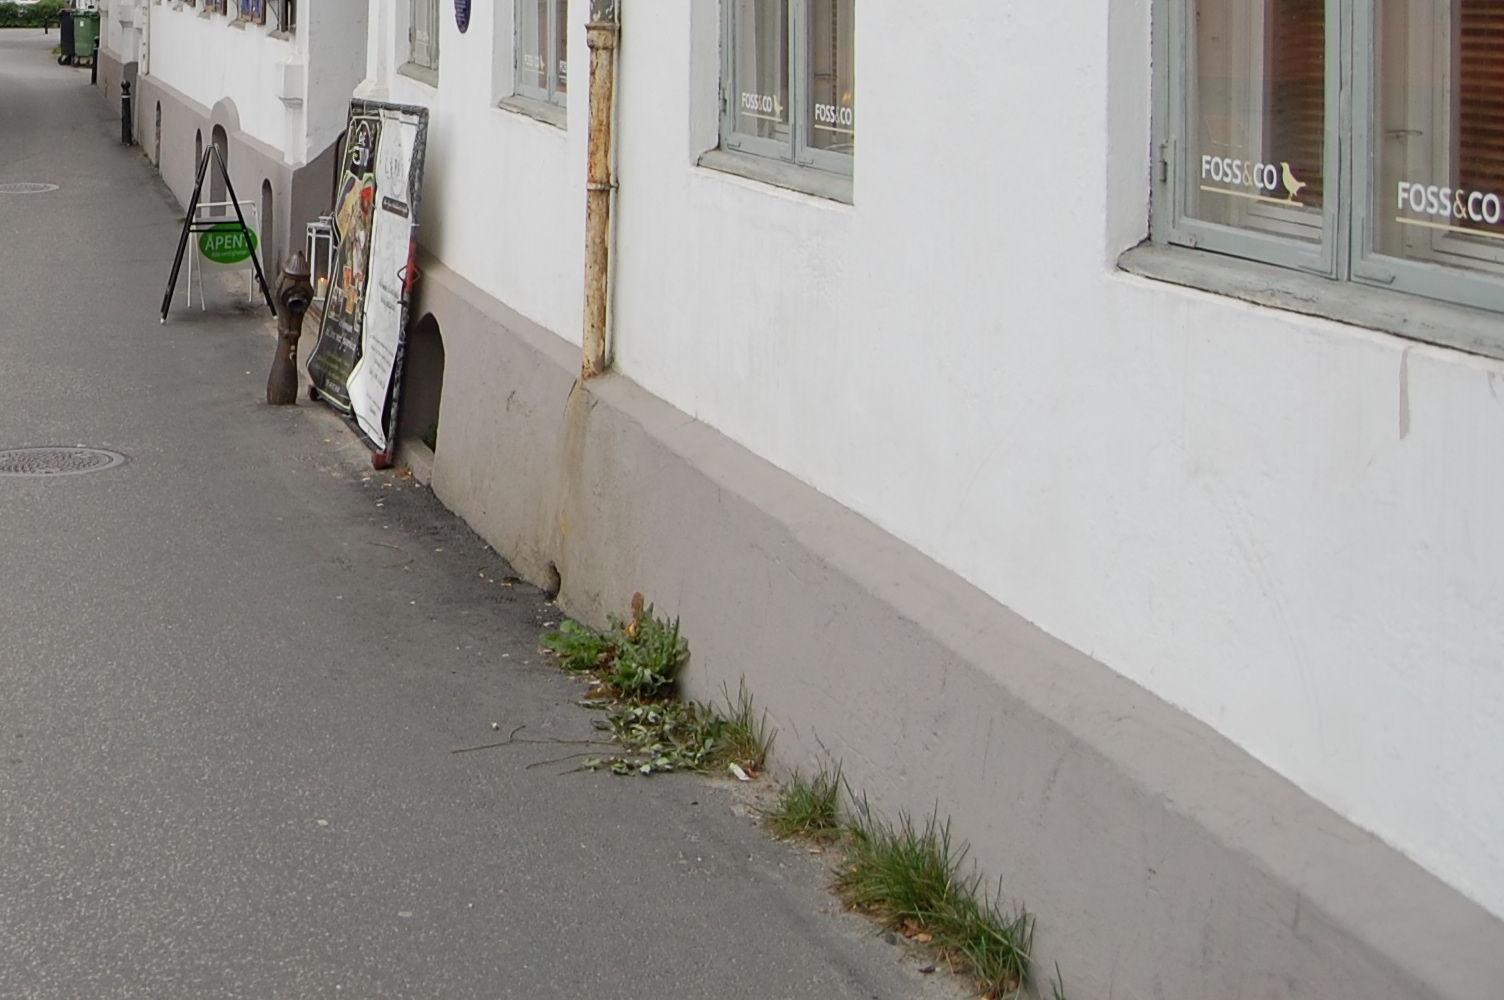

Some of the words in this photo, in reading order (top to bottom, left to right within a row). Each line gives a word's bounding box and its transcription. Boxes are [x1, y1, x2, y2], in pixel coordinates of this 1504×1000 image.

[741, 92, 773, 113] FOSS&CO
[814, 103, 852, 126] FOSS&CO
[1201, 154, 1278, 191] FOSS&CO
[1397, 181, 1501, 224] FOSS&CO
